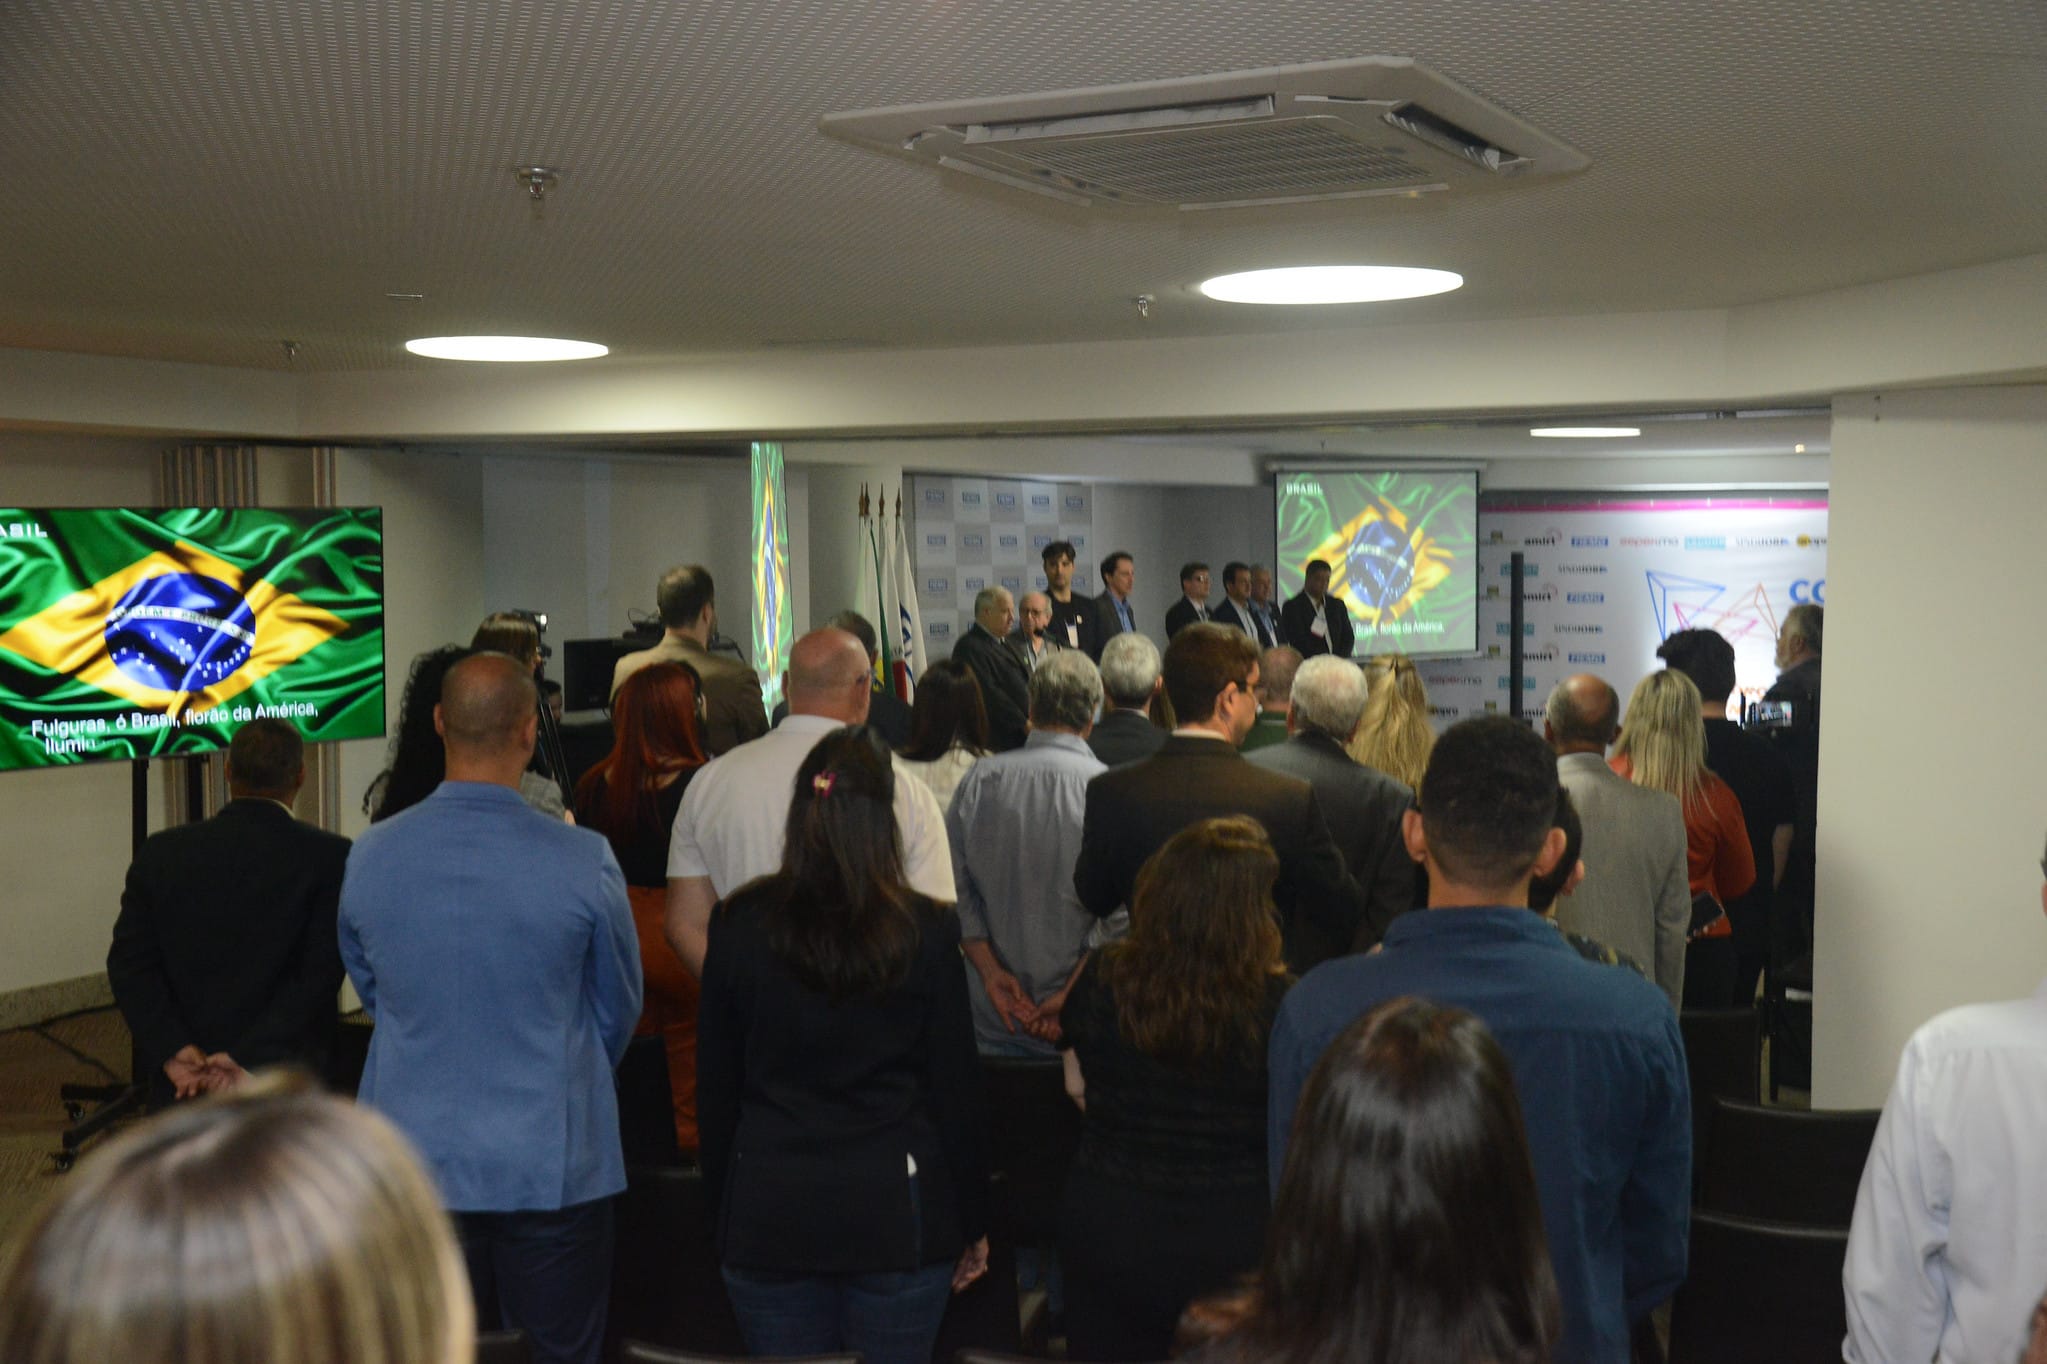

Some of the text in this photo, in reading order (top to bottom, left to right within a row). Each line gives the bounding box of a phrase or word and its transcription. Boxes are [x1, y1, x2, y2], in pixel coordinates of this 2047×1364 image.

[31, 718, 111, 738] Fulguras,
[131, 710, 181, 730] Brasil,
[233, 704, 252, 722] da
[255, 700, 318, 720] América,
